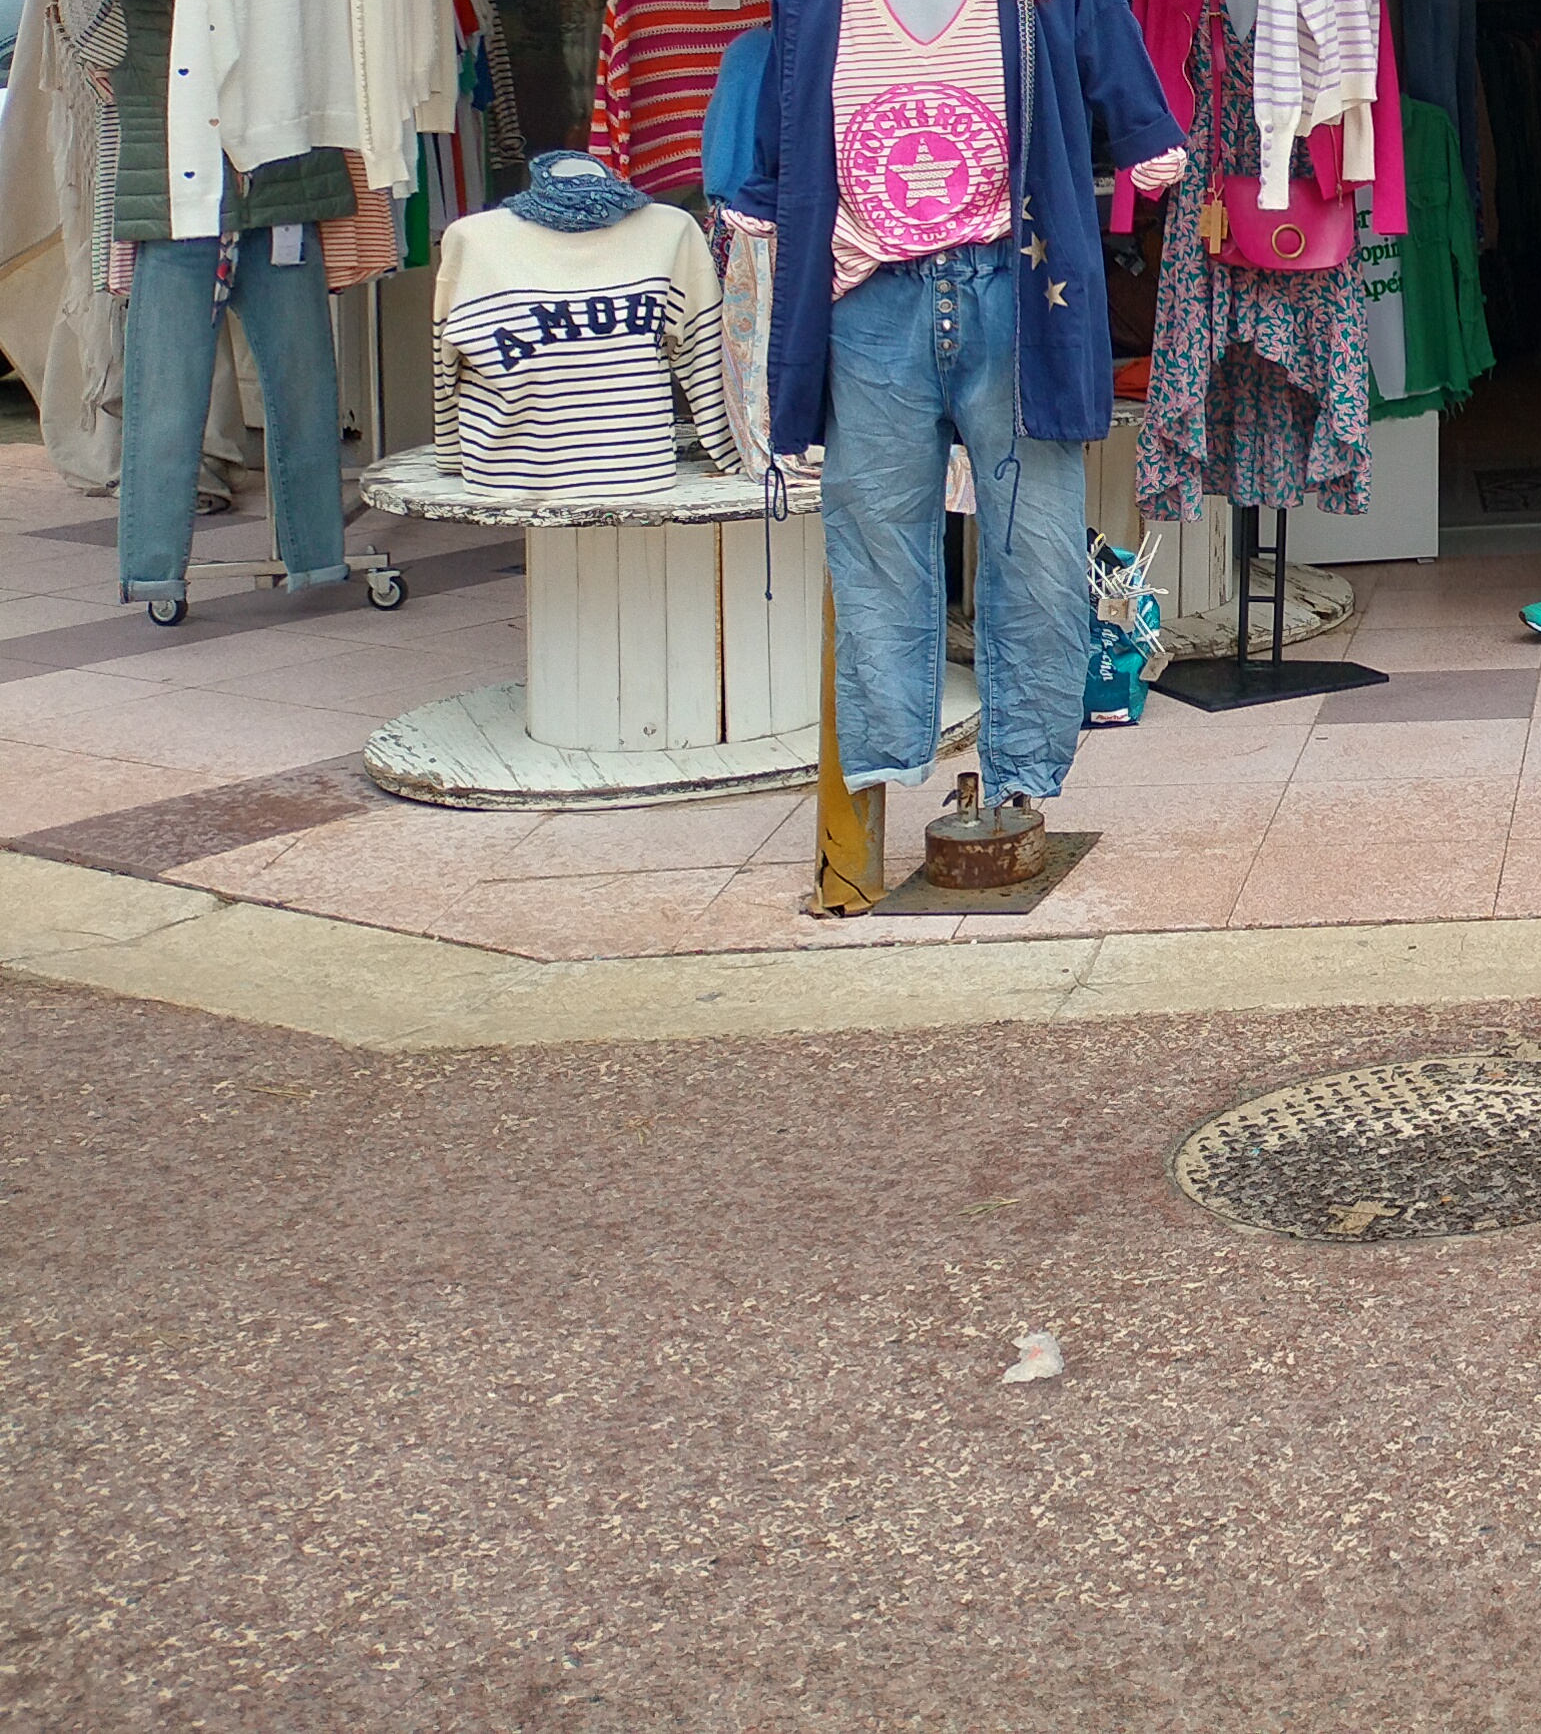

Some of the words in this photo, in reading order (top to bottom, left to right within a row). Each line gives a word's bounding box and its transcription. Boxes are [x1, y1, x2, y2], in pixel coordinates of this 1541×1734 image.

[853, 102, 908, 174] ROCK
[932, 102, 996, 166] ROLL
[492, 294, 666, 372] AMOU
